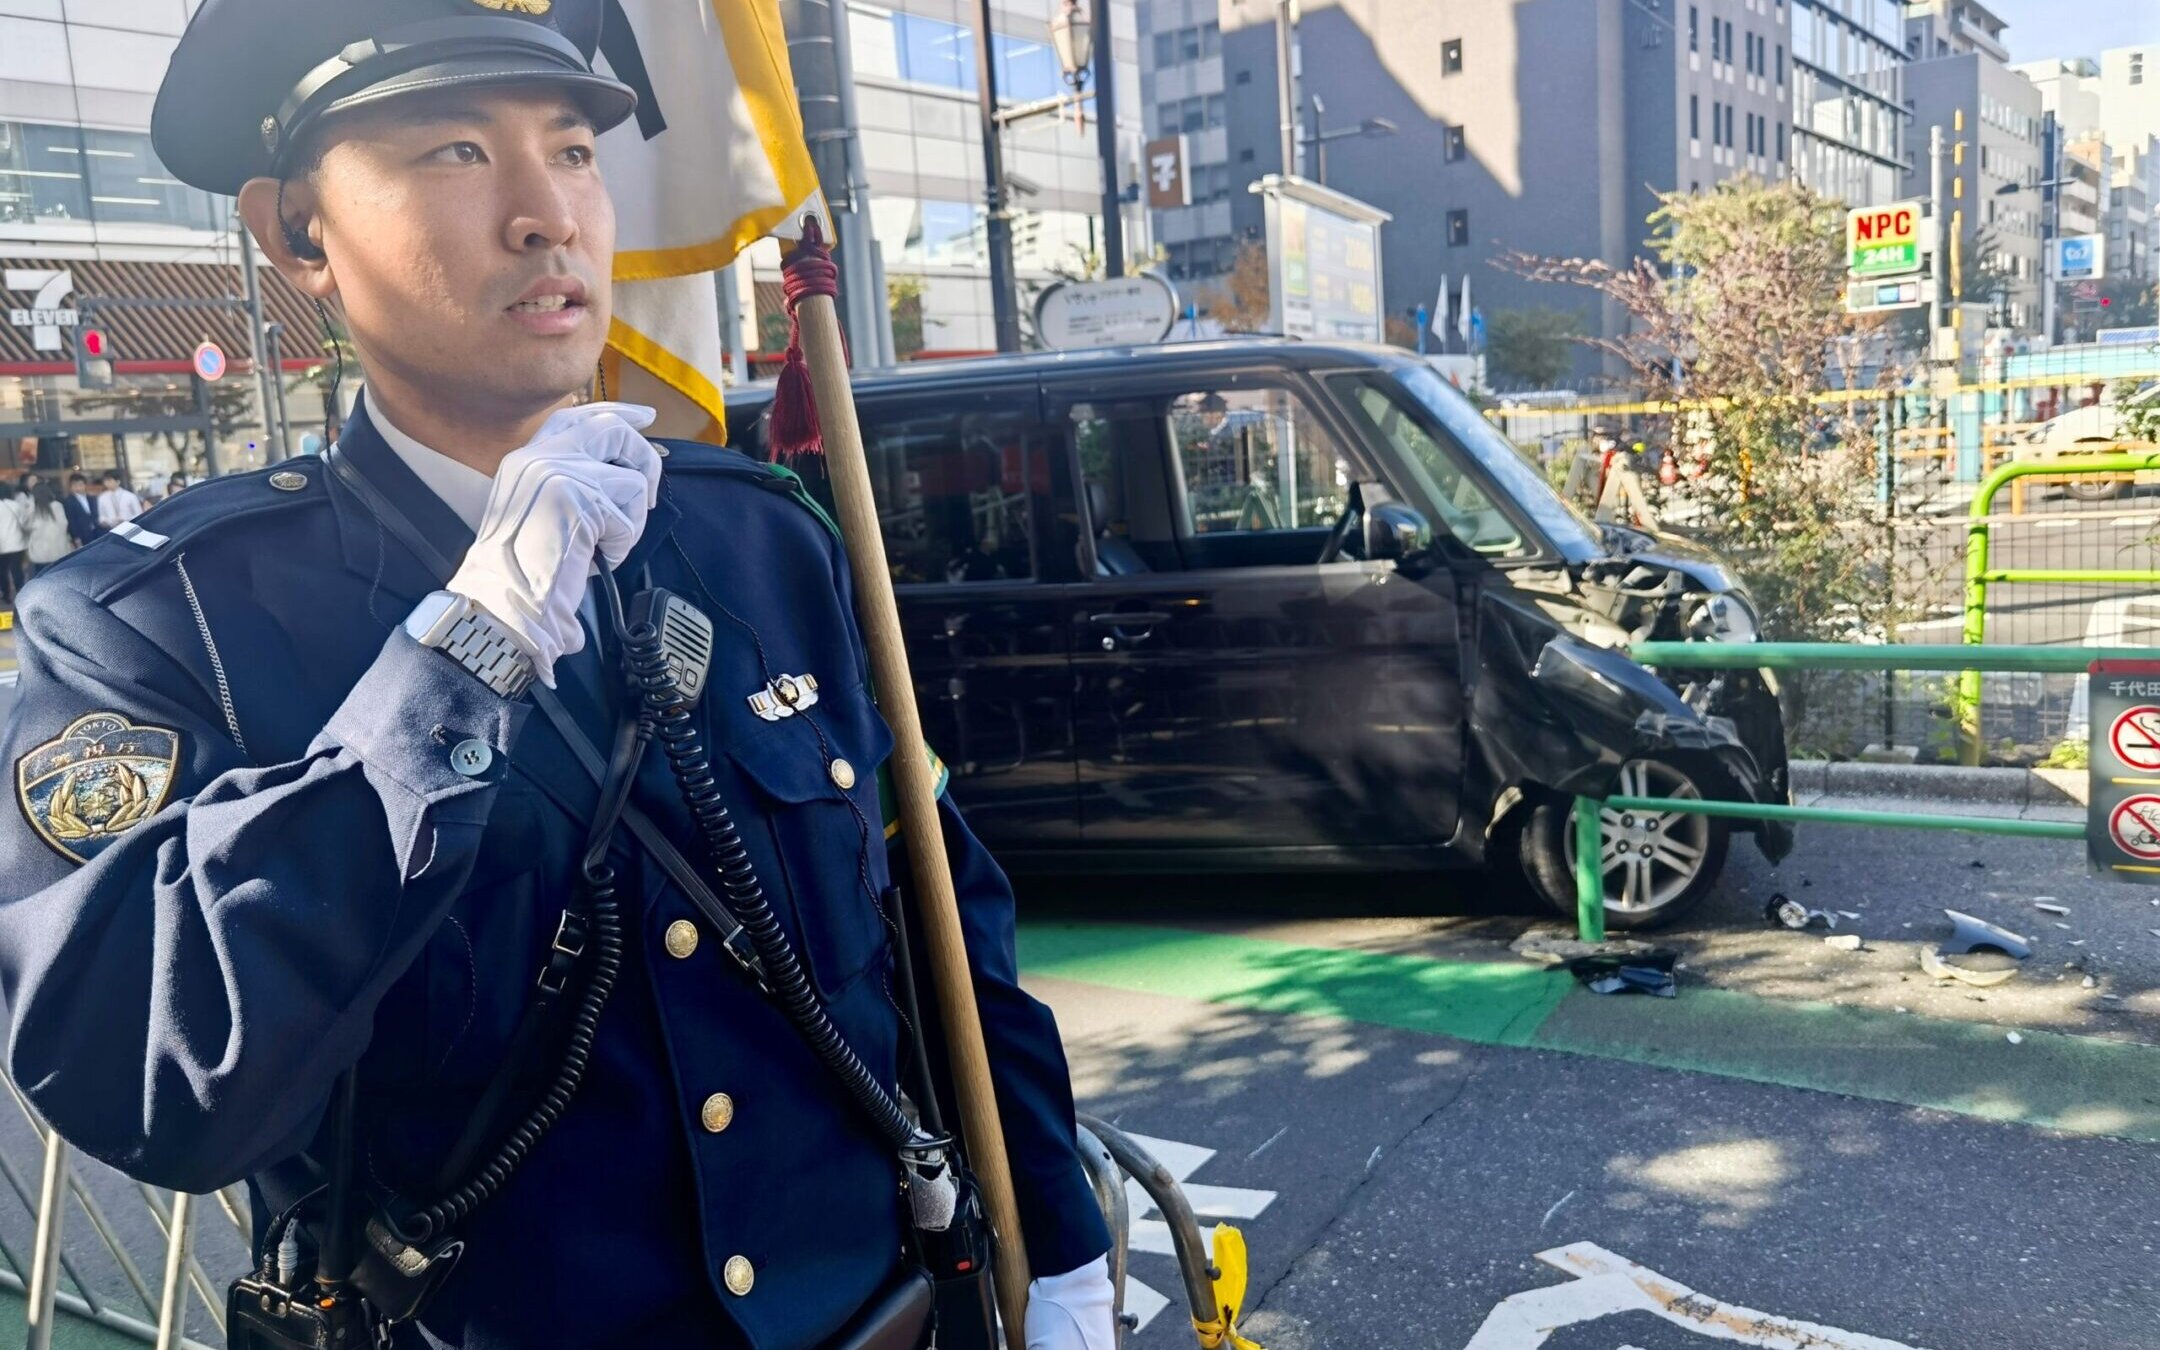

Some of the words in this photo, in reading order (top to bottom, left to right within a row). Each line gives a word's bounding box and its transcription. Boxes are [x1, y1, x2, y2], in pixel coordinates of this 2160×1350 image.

[1857, 211, 1910, 240] NPC
[1862, 246, 1904, 264] 24H
[5, 269, 73, 350] 7
[77, 721, 116, 736] TOKYO
